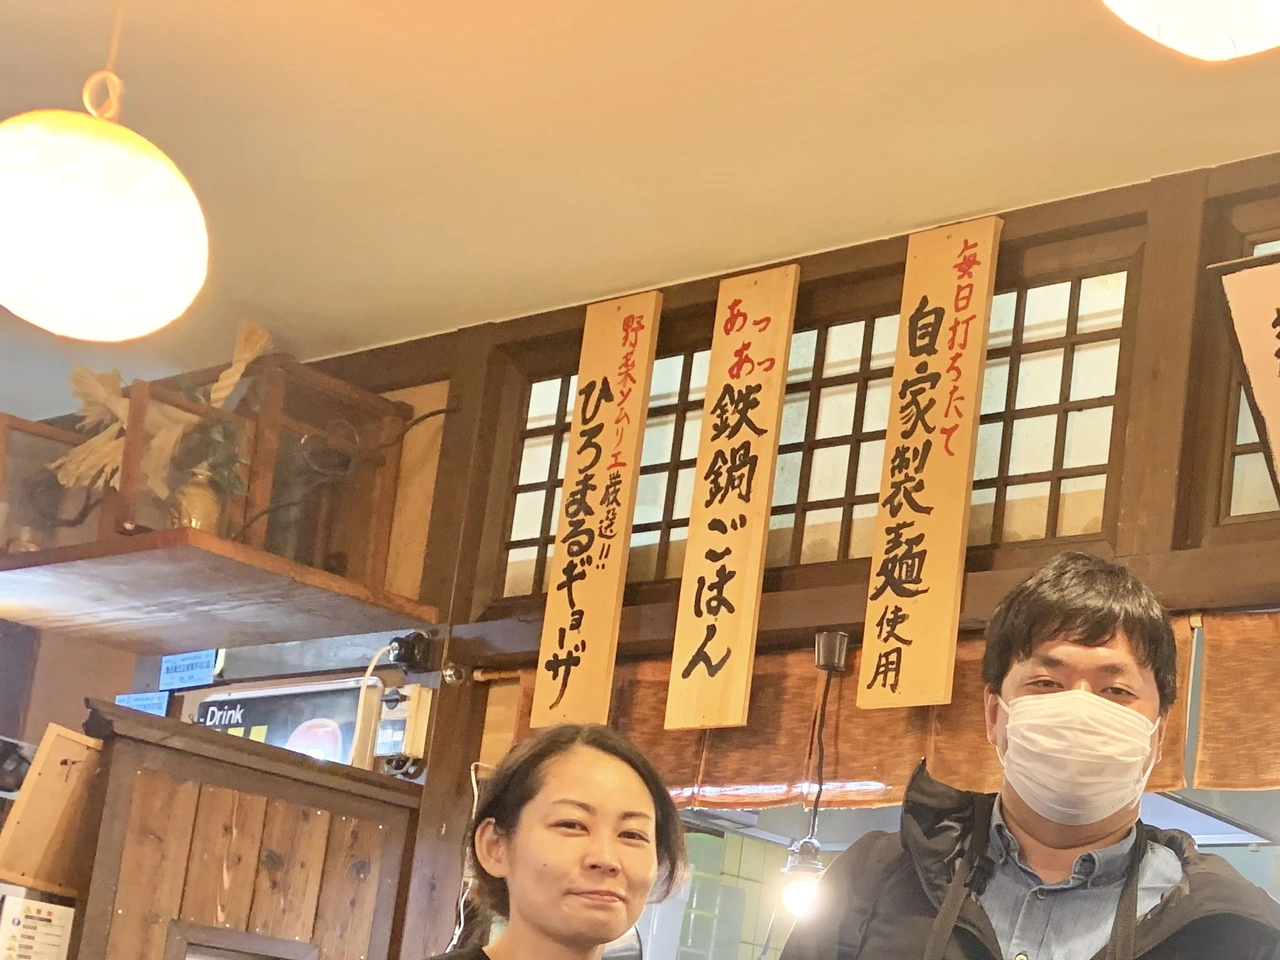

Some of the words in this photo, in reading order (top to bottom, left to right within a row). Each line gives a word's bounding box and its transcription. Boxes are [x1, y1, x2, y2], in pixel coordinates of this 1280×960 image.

[544, 375, 614, 711] ひろまるギョーザ
[867, 295, 944, 694] 自家製麺使用
[205, 703, 245, 726] Drink
